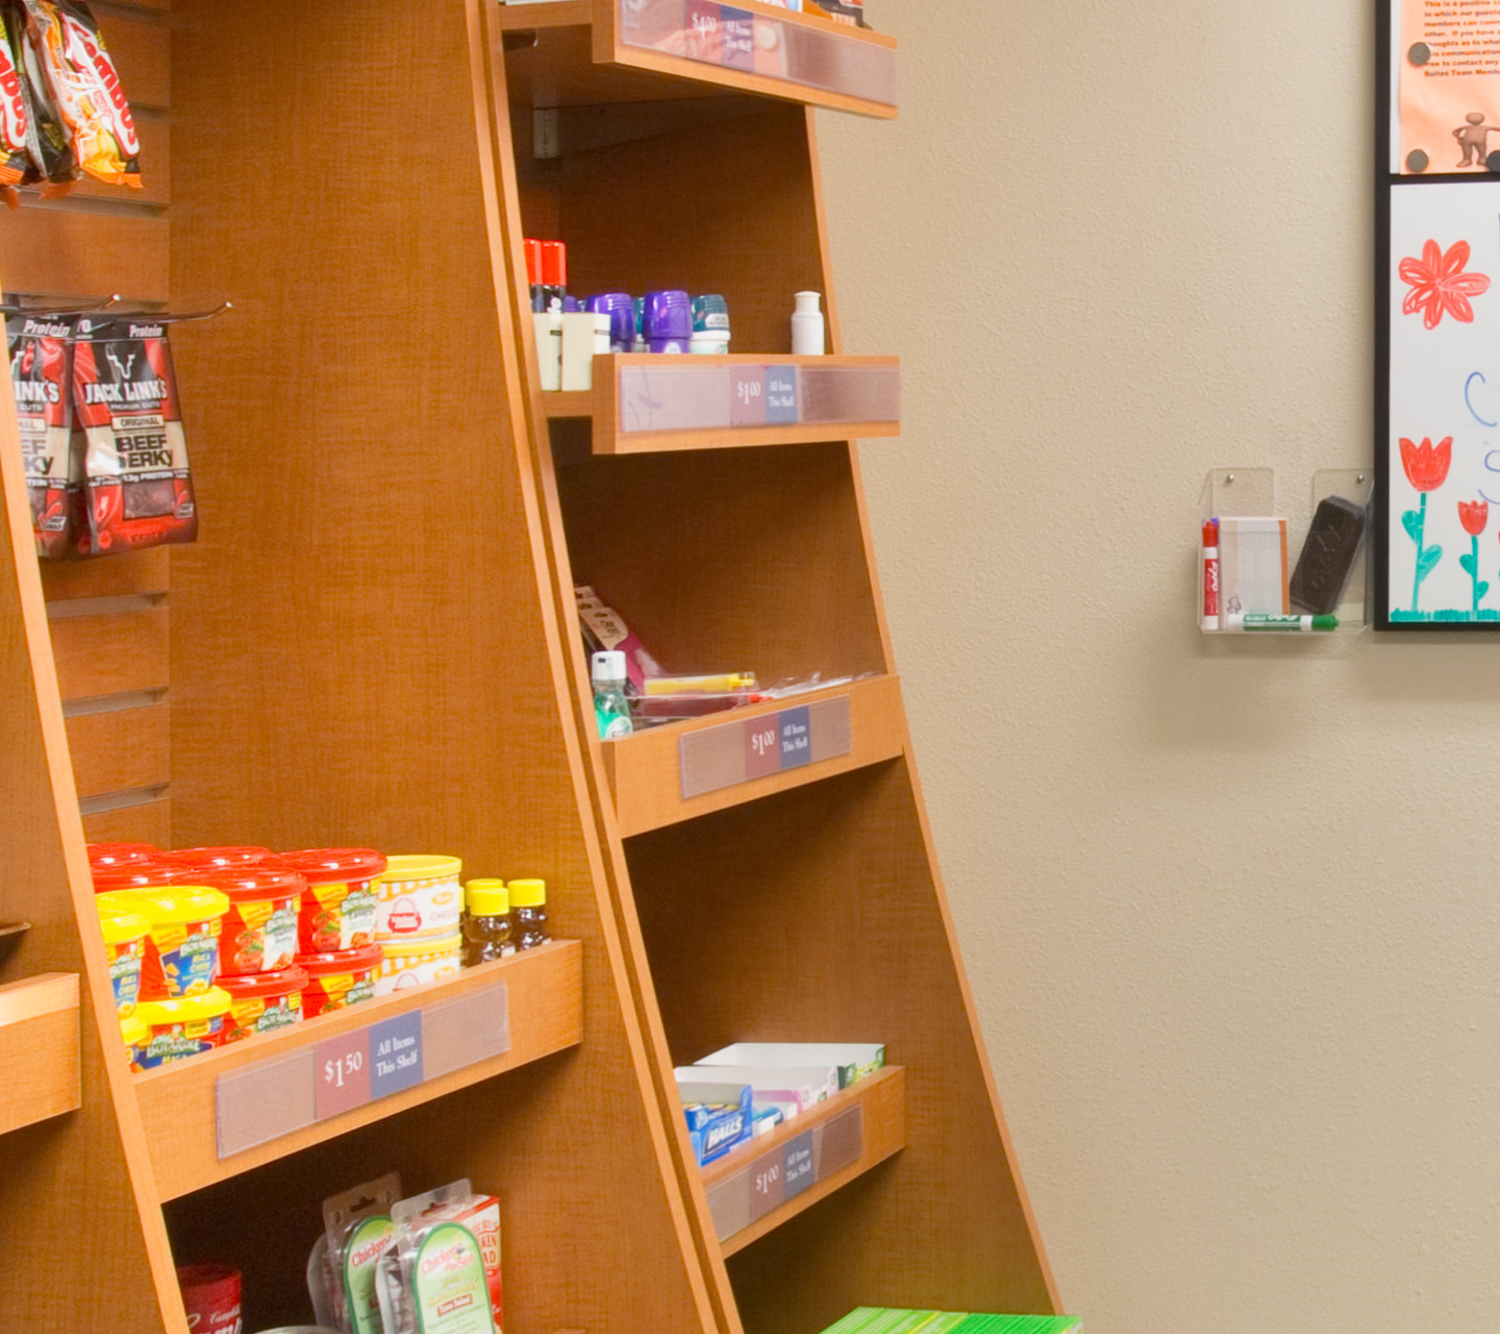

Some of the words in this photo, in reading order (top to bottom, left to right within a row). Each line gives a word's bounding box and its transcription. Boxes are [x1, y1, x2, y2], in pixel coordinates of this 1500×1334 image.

[24, 320, 70, 337] Protein
[130, 325, 162, 338] Protein
[84, 383, 123, 404] JACK
[124, 379, 168, 401] LINK'S
[120, 418, 160, 427] ORIGINAL
[115, 434, 167, 452] BEEF
[377, 1040, 392, 1057] All
[394, 1034, 415, 1050] Items
[376, 1062, 394, 1078] This
[396, 1051, 418, 1070] Shelf
[707, 1117, 743, 1148] HALLS
